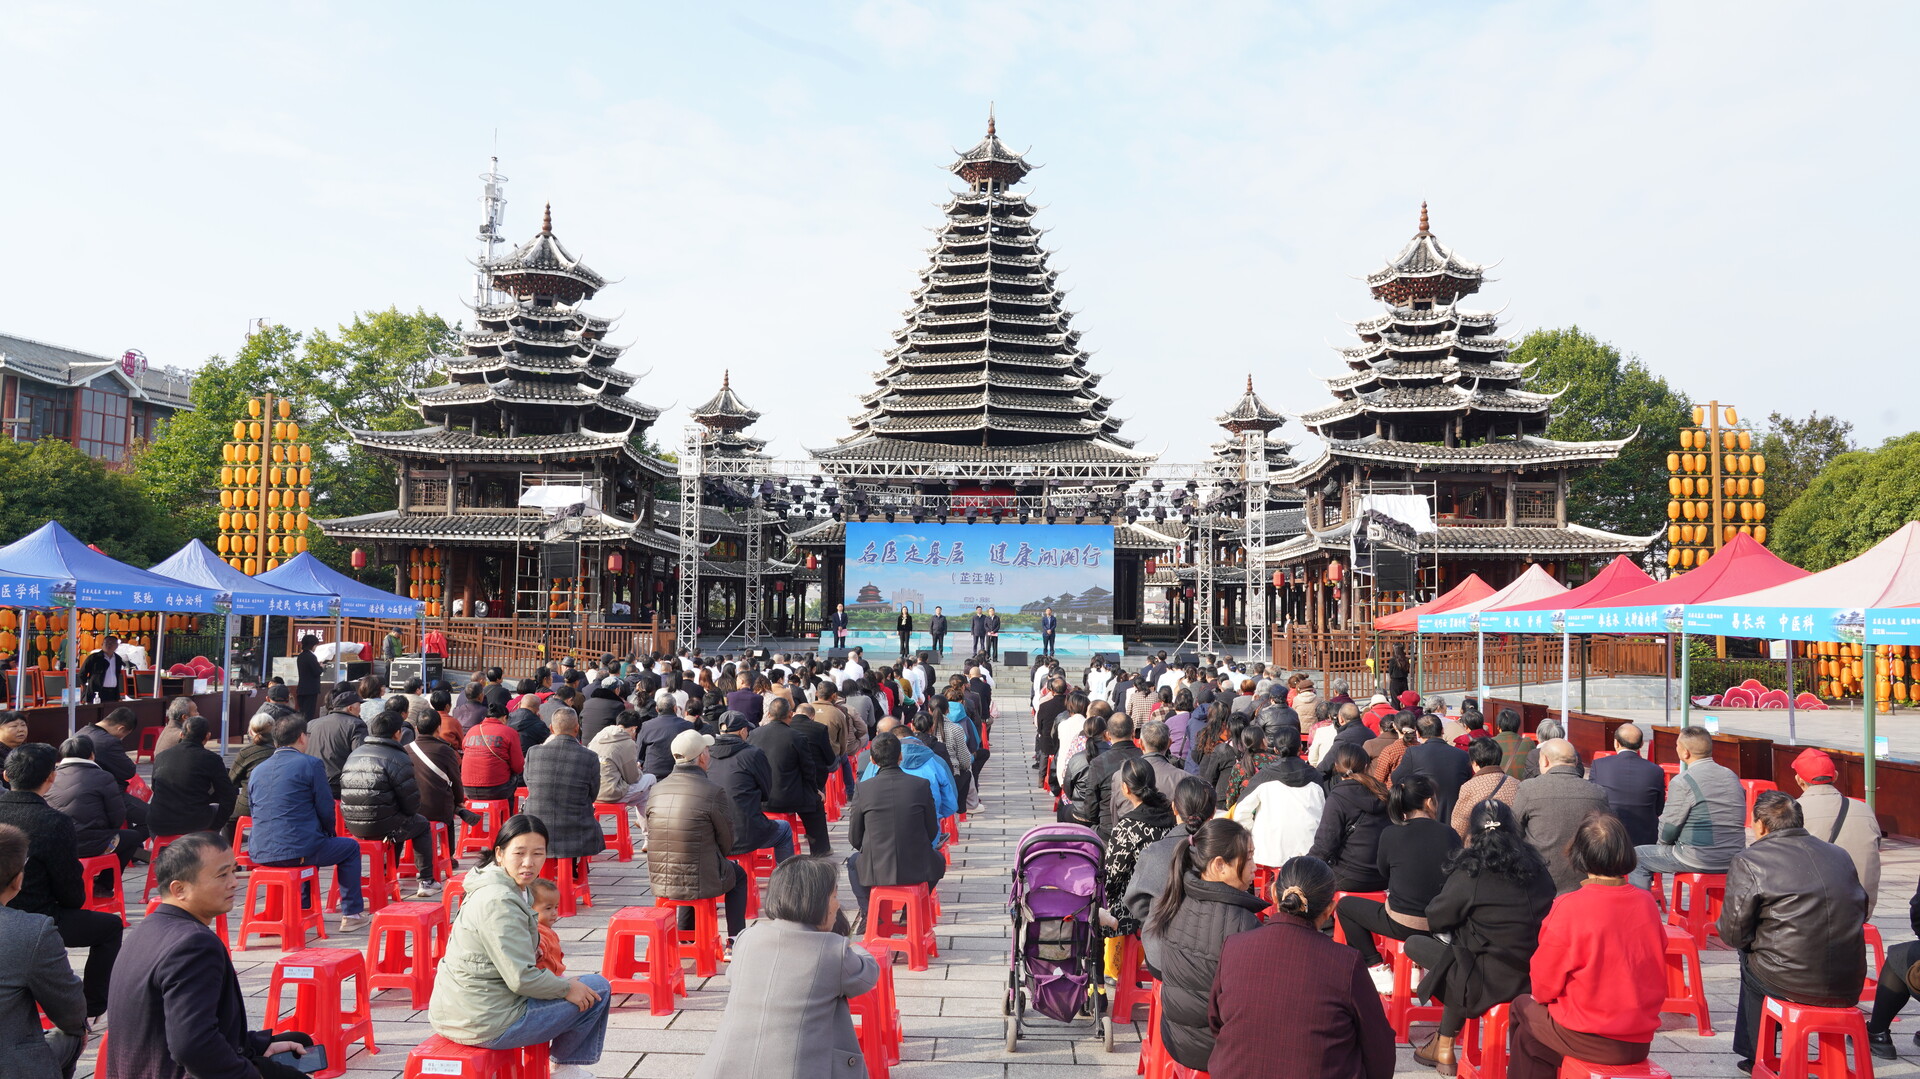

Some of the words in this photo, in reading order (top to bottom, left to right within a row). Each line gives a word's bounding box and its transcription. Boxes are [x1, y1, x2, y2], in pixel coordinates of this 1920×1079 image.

[857, 540, 966, 566] 名医走基层
[989, 541, 1102, 569] 健康湖湘行
[165, 592, 203, 608] 内分泌科
[295, 600, 324, 612] 呼吸内科
[387, 604, 413, 615] 心血管内科
[1778, 613, 1815, 635] 中医科
